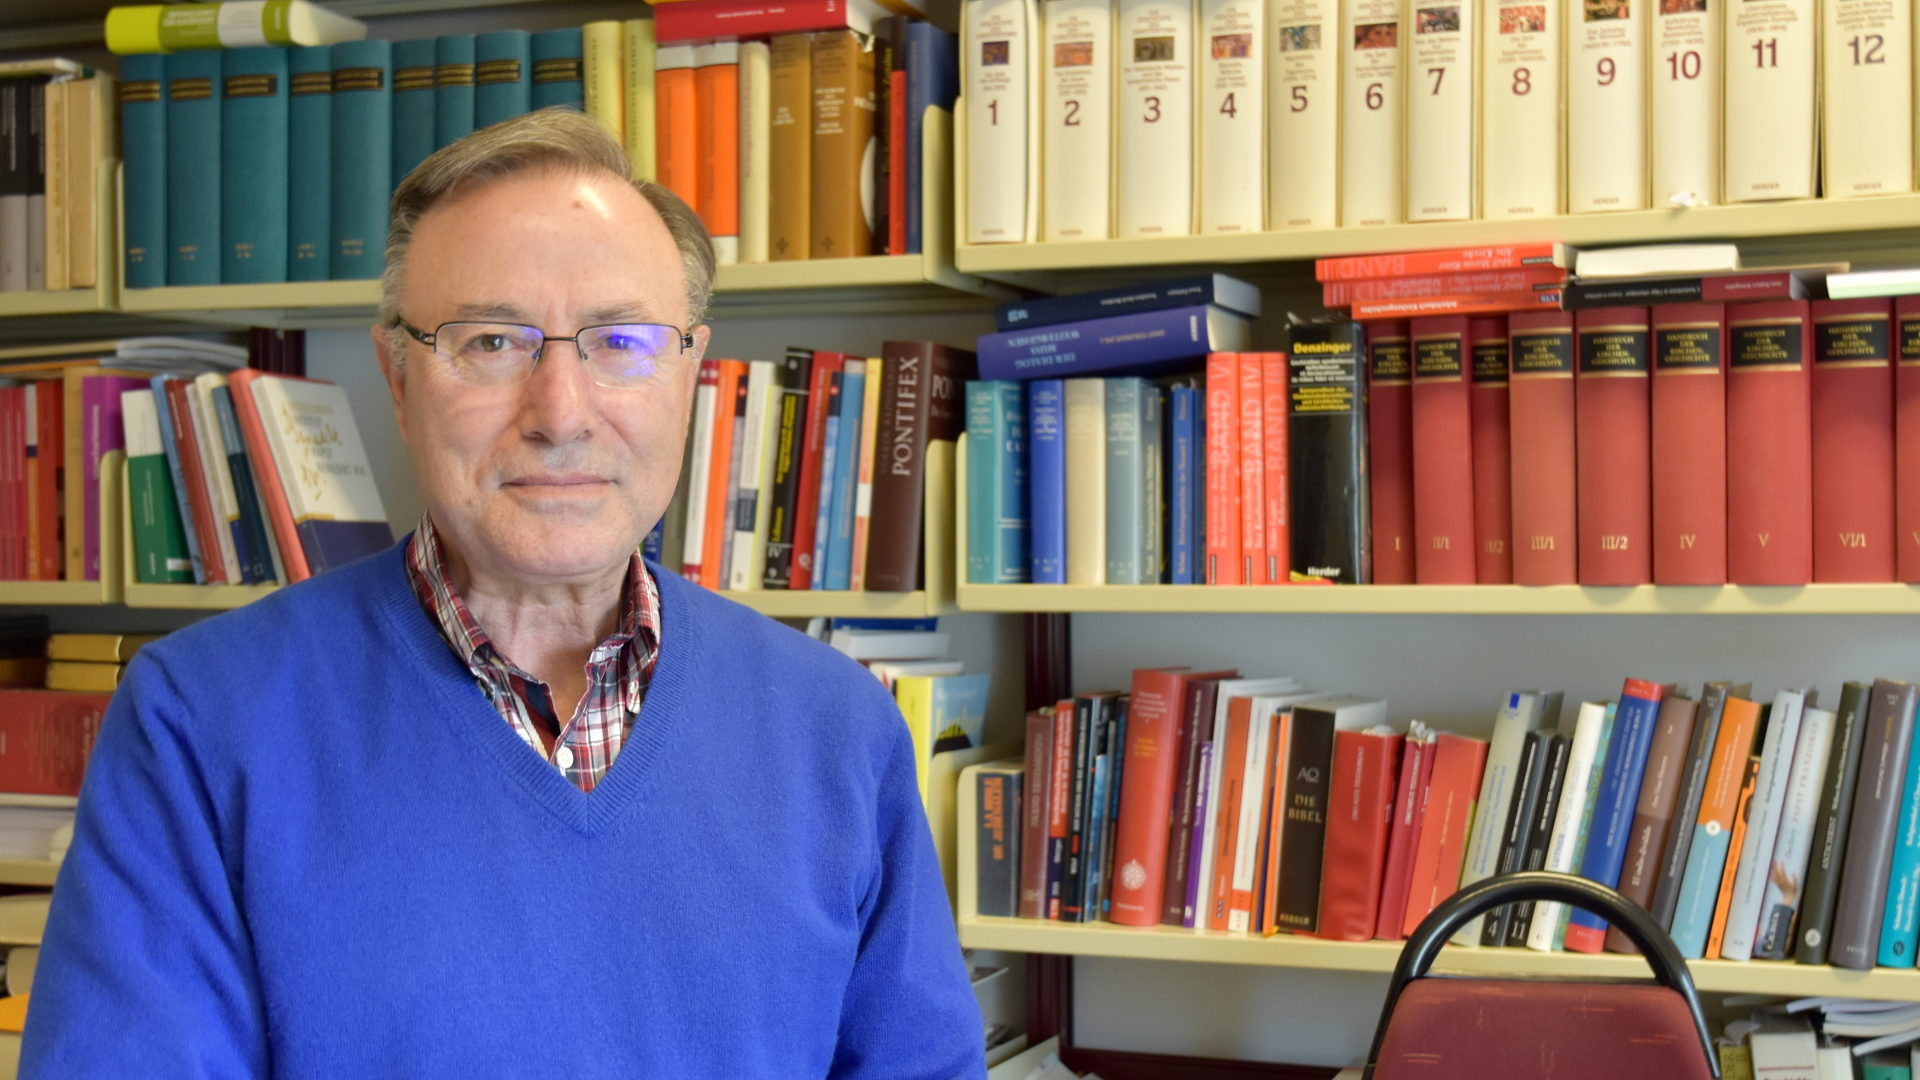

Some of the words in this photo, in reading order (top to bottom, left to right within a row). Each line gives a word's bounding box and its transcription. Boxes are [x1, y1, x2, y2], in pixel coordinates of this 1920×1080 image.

[1751, 38, 1778, 68] 11
[1847, 34, 1886, 66] 12
[1597, 57, 1616, 86] 9
[1667, 51, 1701, 80] 10
[1428, 67, 1446, 96] 7
[1512, 67, 1532, 96] 8
[1220, 92, 1237, 118] 4
[1290, 85, 1308, 113] 5
[1365, 82, 1384, 111] 6
[988, 99, 998, 126] 1
[1064, 100, 1081, 127] 2
[1143, 96, 1161, 123] 3
[1340, 256, 1405, 279] BAND
[1666, 332, 1708, 340] HANDBUCH
[1828, 325, 1872, 334] HANDBUCH
[1293, 342, 1352, 354] Denzinger
[1593, 336, 1634, 344] HANDBUCH
[1665, 354, 1710, 363] GESCHICHTE
[1826, 347, 1875, 356] GESCHICHTE
[1591, 357, 1636, 365] GESCHICHTE
[892, 356, 919, 476] PONTIFEX
[1266, 394, 1286, 471] BAND
[1531, 536, 1555, 550] III/1
[1601, 535, 1628, 550] III/2
[1680, 535, 1696, 549] IV
[1758, 533, 1770, 548] V
[1839, 533, 1867, 548] VI/1
[1307, 566, 1341, 578] Herder
[1295, 794, 1316, 808] DIE
[1288, 808, 1322, 823] BIBEL
[1280, 913, 1310, 926] HERDER
[1487, 920, 1498, 937] 4
[1511, 920, 1526, 939] 11
